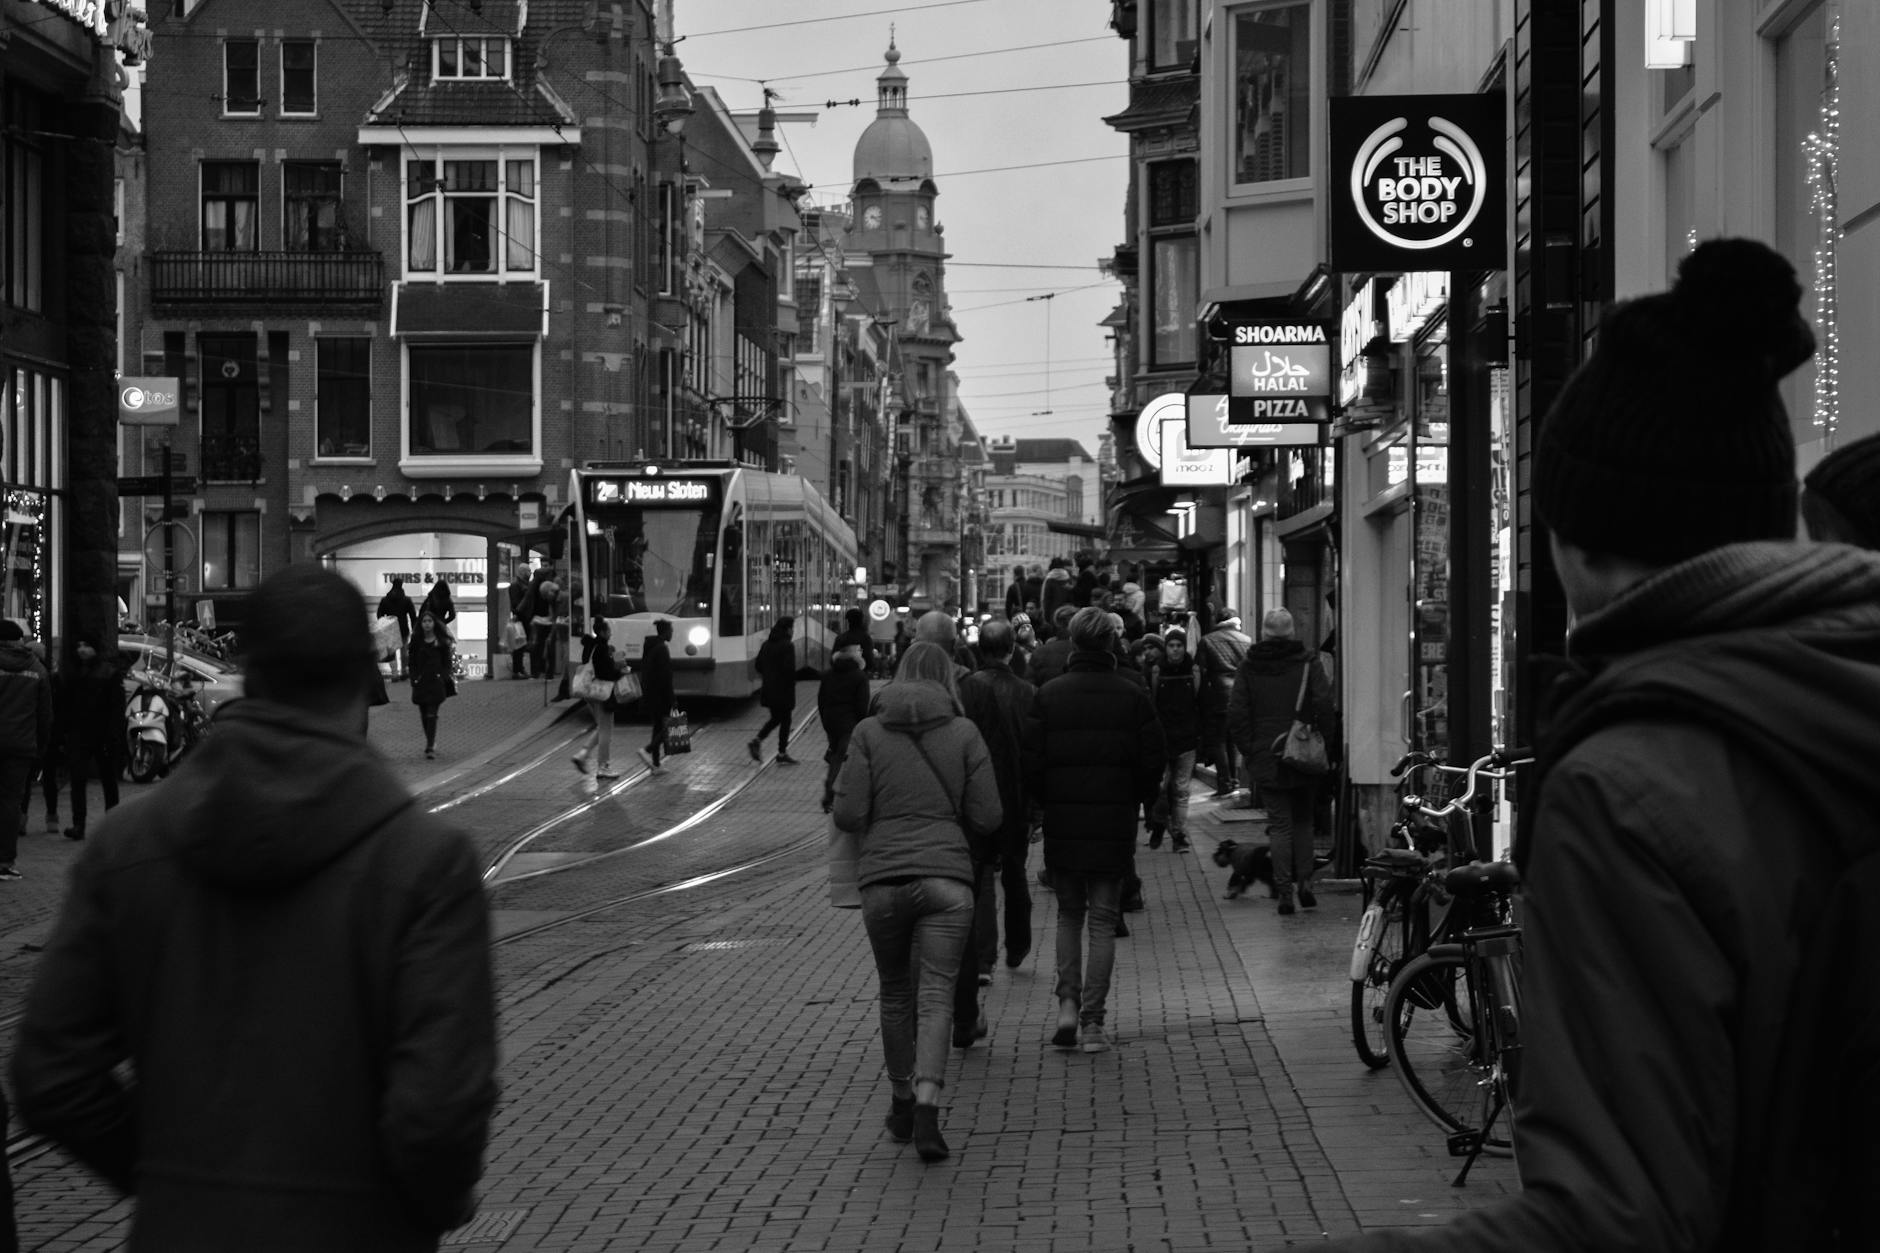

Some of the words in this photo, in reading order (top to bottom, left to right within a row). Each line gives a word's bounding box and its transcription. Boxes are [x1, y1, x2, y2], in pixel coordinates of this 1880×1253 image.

[1393, 156, 1442, 177] THE
[1378, 176, 1462, 201] BODY
[1383, 201, 1457, 224] SHOP
[1235, 325, 1326, 343] SHOARMA
[1252, 351, 1310, 377] حلال
[1254, 377, 1308, 391] HALAL
[1254, 399, 1309, 417] PIZZA
[628, 481, 665, 499] Nieuw
[667, 481, 708, 499] Sloten
[382, 572, 421, 584] TOURS
[424, 572, 434, 583] &
[435, 572, 484, 584] TICKETS
